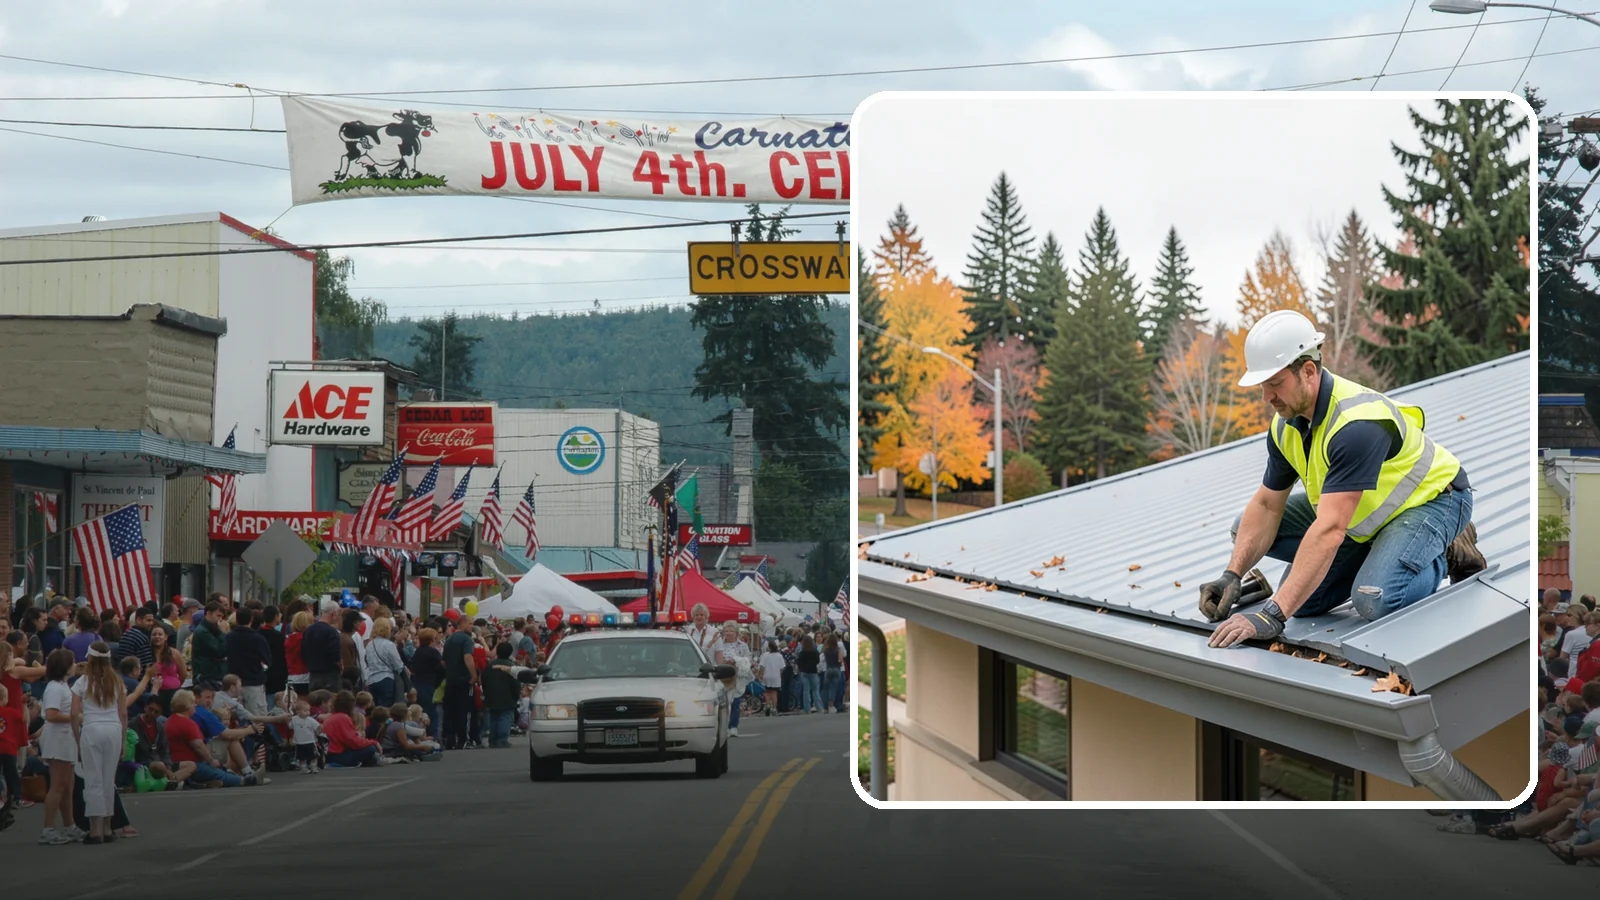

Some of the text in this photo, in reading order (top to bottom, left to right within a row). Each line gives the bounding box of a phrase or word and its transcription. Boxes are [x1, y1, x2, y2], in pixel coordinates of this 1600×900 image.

[481, 141, 605, 192] JULY
[632, 150, 746, 198] 4th.
[696, 254, 850, 280] CROSSWA
[283, 380, 373, 420] ACE
[406, 409, 452, 422] CEDAR
[283, 421, 371, 436] Hardware
[416, 427, 477, 447] Coca-Cola
[354, 467, 385, 480] Simpl
[96, 485, 124, 495] Vincent
[126, 486, 136, 495] de
[138, 486, 155, 495] Paul
[212, 516, 331, 535] HARDARE
[688, 522, 741, 535] CRNATION
[699, 535, 730, 543] GLASS
